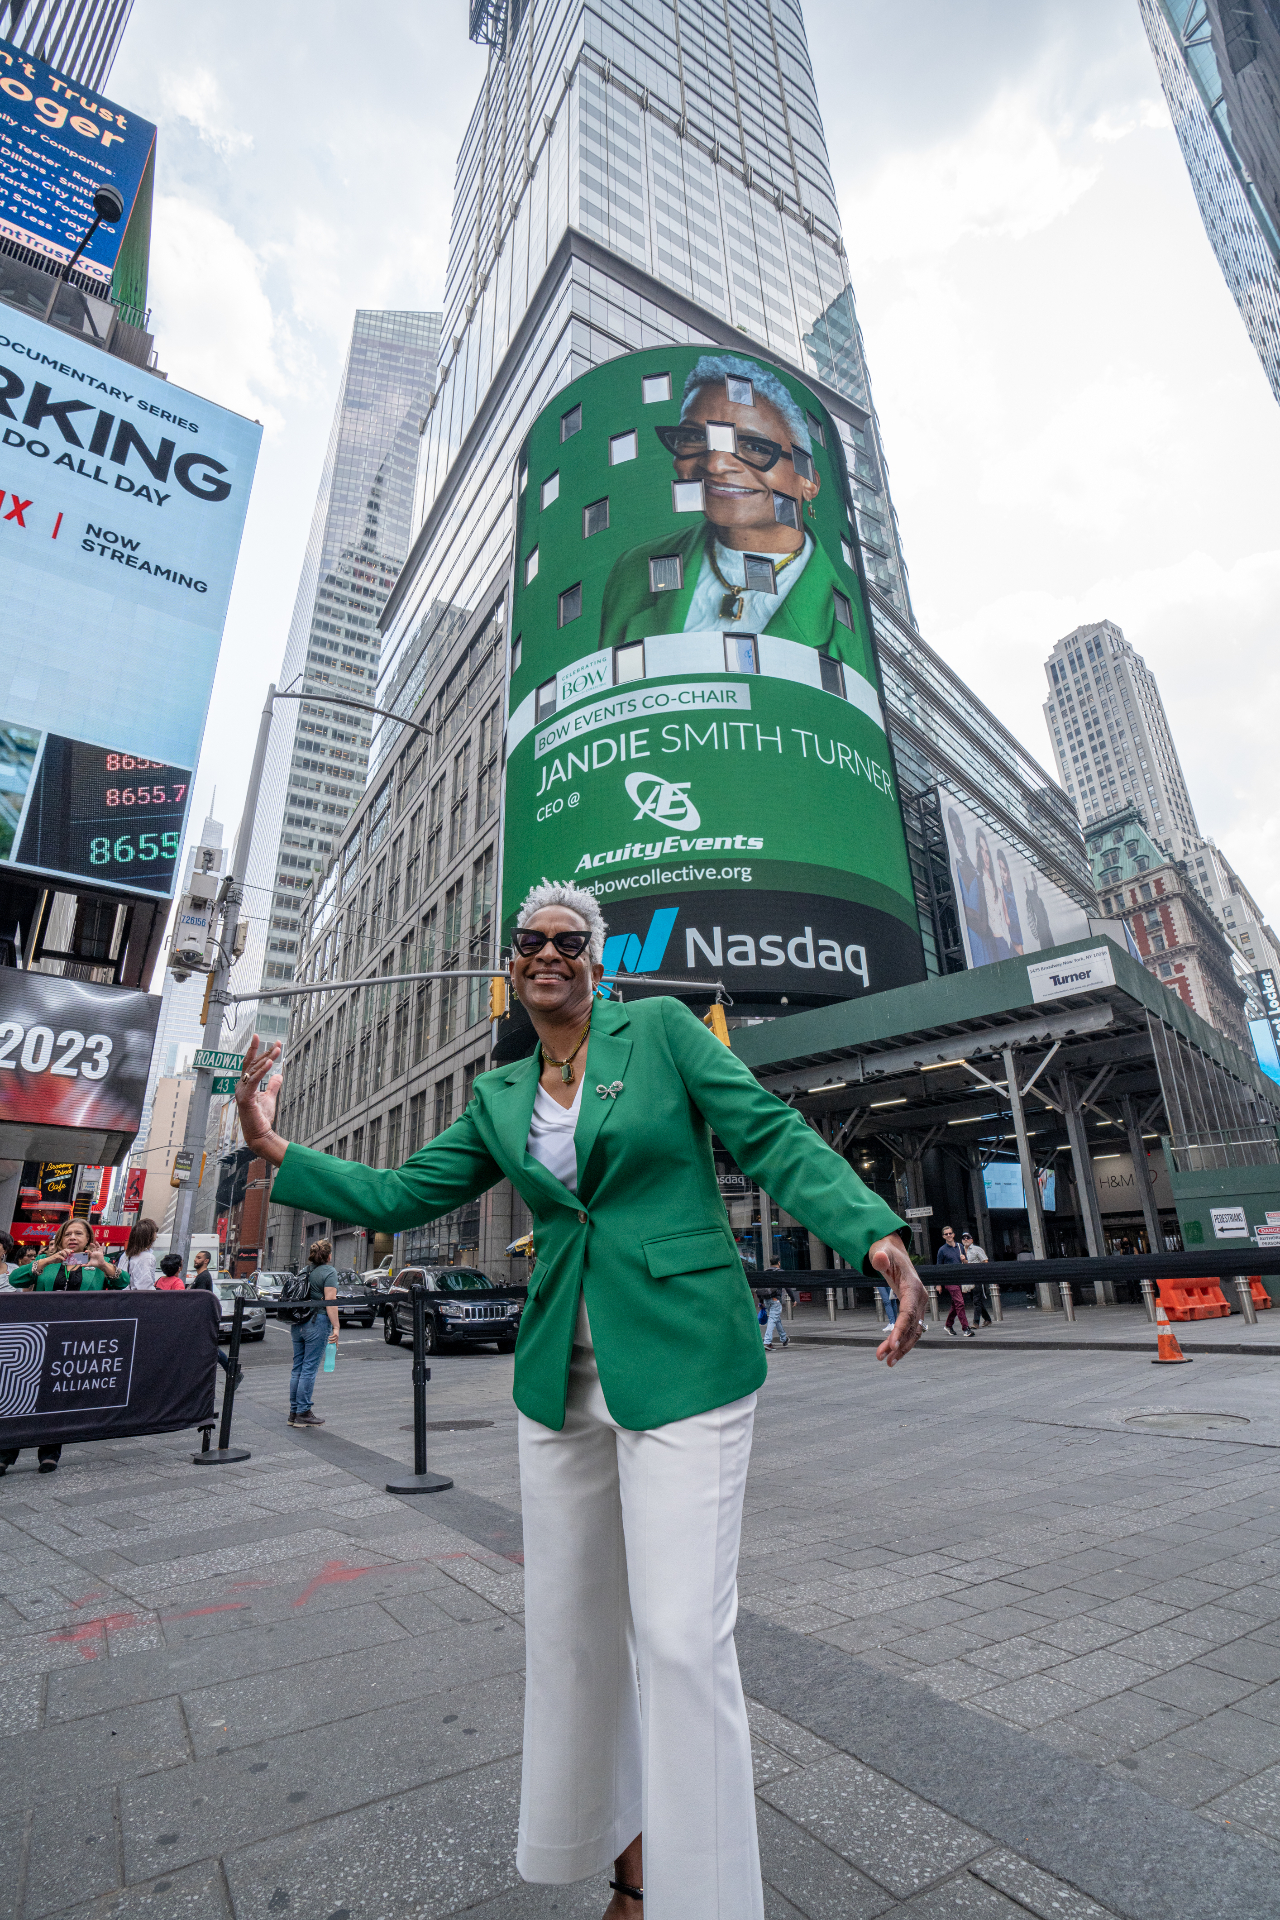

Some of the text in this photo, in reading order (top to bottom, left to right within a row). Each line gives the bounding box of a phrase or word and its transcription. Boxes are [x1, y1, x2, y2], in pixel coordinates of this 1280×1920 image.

[0, 71, 125, 147] oger
[48, 75, 127, 130] Trust
[0, 112, 116, 177] ily of Companies:
[18, 141, 61, 168] Teeter
[1, 146, 47, 175] Dillons
[42, 181, 69, 198] City
[13, 193, 48, 214] Save
[22, 210, 53, 230] Less
[98, 221, 116, 234] Co
[137, 399, 200, 434] SERIES
[2, 427, 171, 507] DO ALL DAY
[85, 523, 141, 552] NOW
[80, 538, 208, 593] STREAMING
[561, 656, 607, 682] CELEBRATING
[562, 665, 608, 701] BOW
[538, 690, 738, 751] BOW EVENTS CO-CHAIR
[536, 721, 894, 801] JANDIE SMITH TURNER
[105, 784, 187, 806] 8655.7
[536, 792, 581, 822] CEO @
[574, 835, 764, 873] AcuityEvents
[181, 914, 207, 927] 726156
[685, 926, 870, 988] Nasdaq
[1049, 969, 1092, 987] Turner
[0, 1021, 113, 1081] 2023
[216, 1078, 230, 1093] 43
[47, 1181, 66, 1192] Cafe
[1099, 1174, 1135, 1189] H&M
[1213, 1213, 1243, 1224] PEDESTRIANS
[61, 1339, 119, 1356] TIMES
[50, 1357, 123, 1378] SQUARE
[52, 1377, 117, 1393] ALLIANCE
